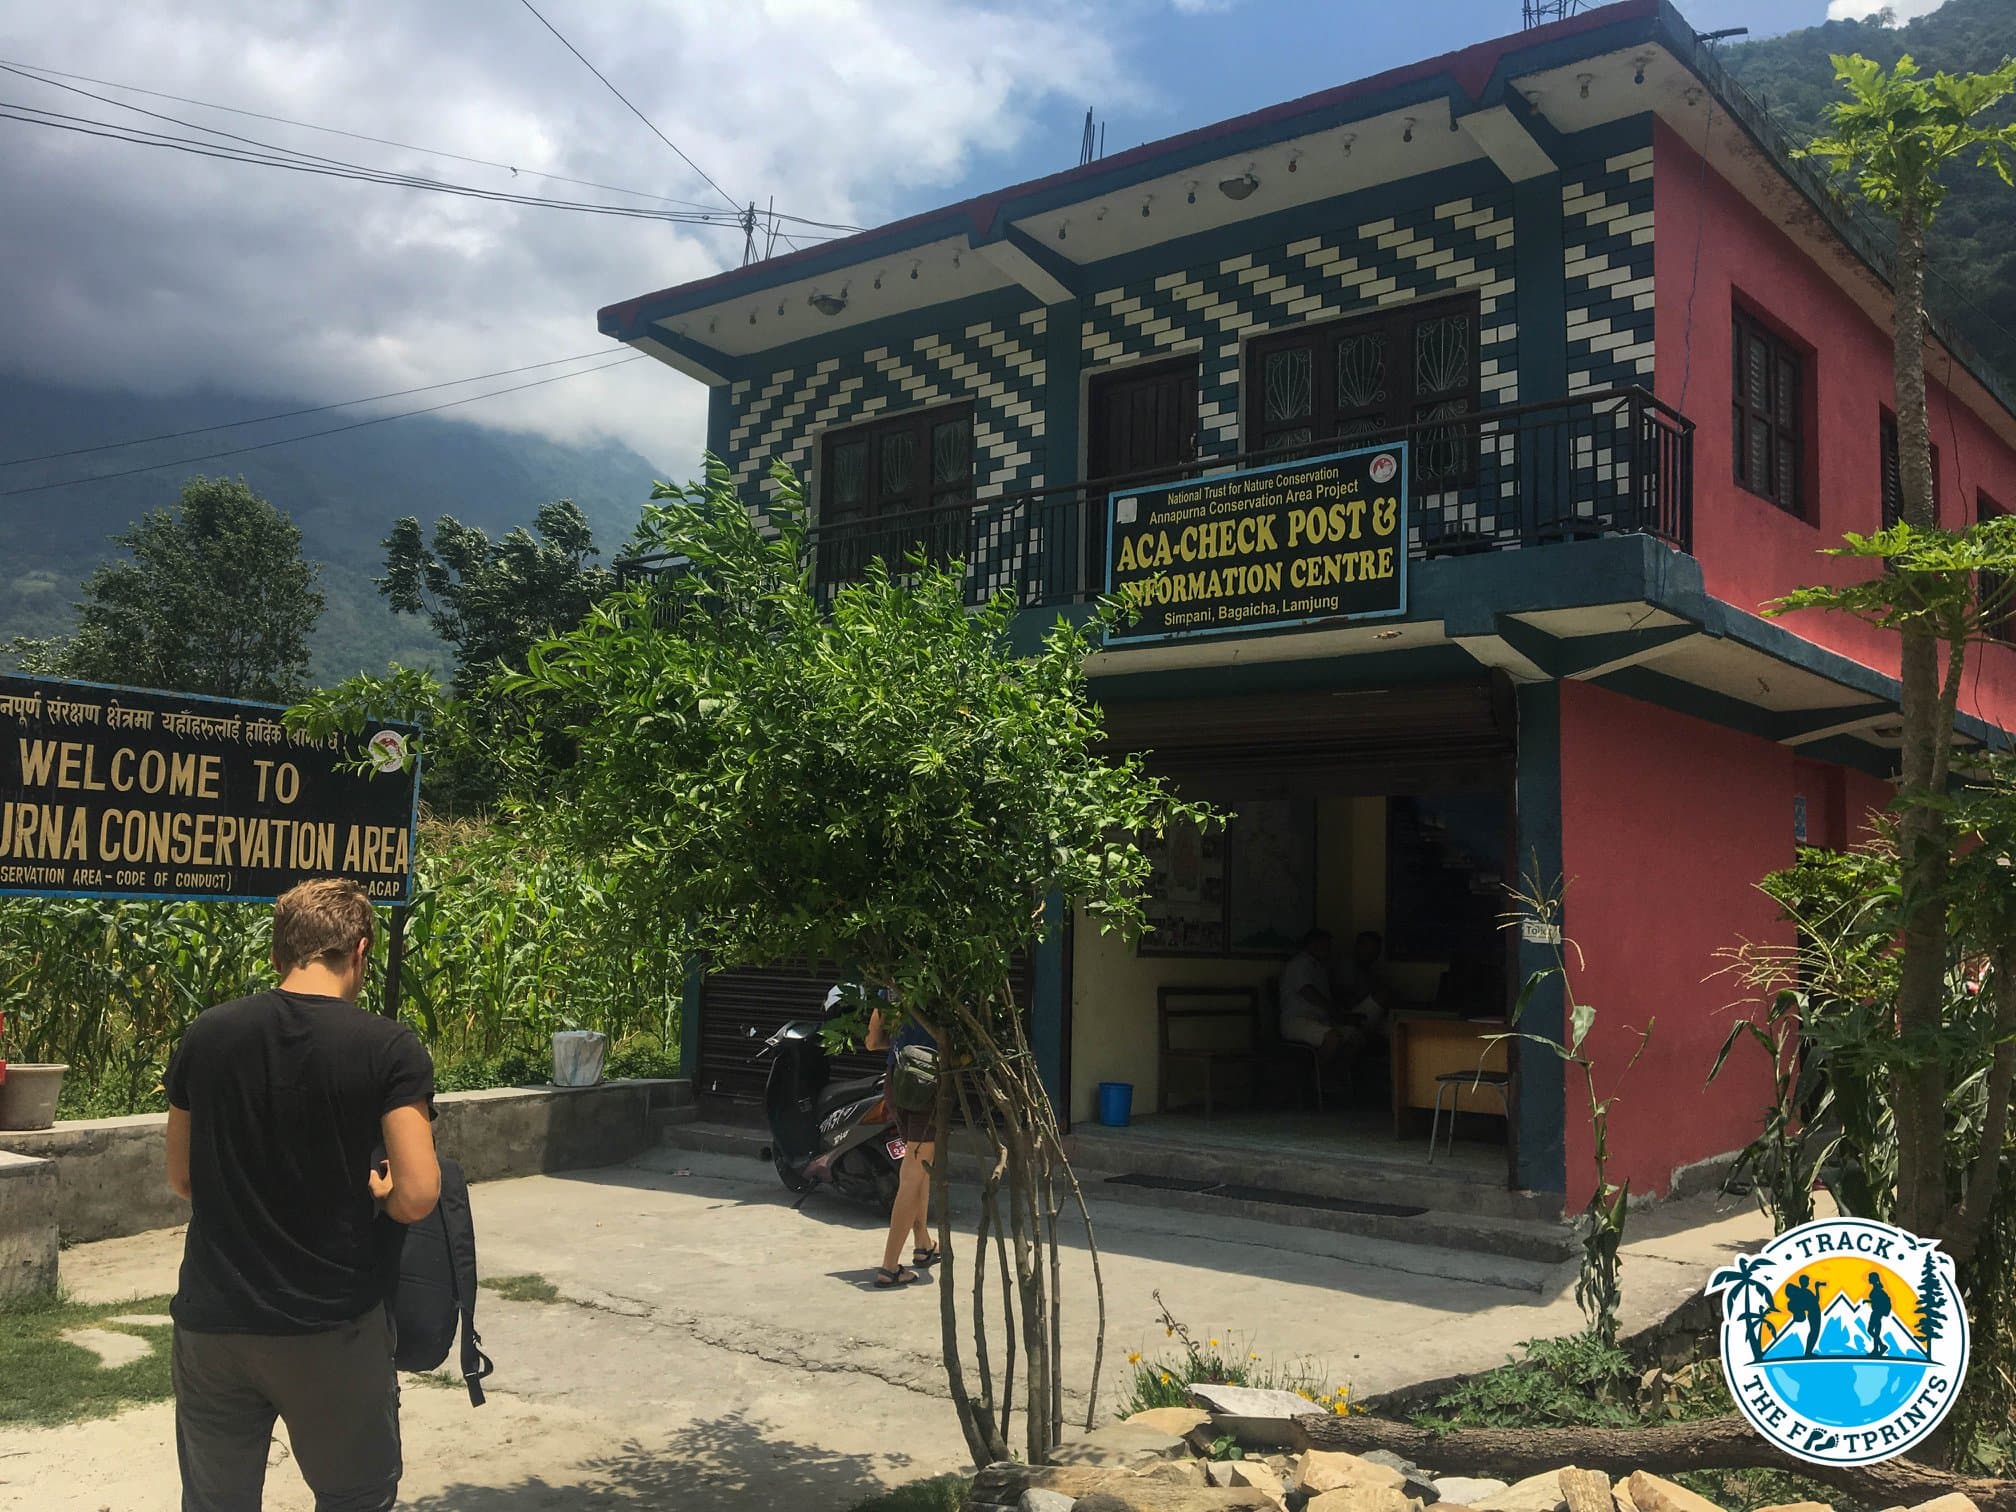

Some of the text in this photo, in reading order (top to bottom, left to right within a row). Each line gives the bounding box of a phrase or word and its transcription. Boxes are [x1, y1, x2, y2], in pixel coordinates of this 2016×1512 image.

[1149, 479, 1359, 525] Annapurna Conservation Area Project
[1167, 466, 1339, 505] National Trust for Nature Conservation
[1116, 496, 1397, 572] ACA-CHECK POST &
[1121, 547, 1394, 609] NFORMATION CENTRE
[1164, 595, 1339, 626] Simpani, Bagaicha, Lamjung
[46, 696, 101, 727] संरक्षण
[18, 737, 299, 804] WELCOME TO
[100, 808, 335, 871] CONSERVATION
[343, 824, 409, 875] AREA
[154, 871, 169, 887] OF
[175, 872, 232, 892] CONDUCT)
